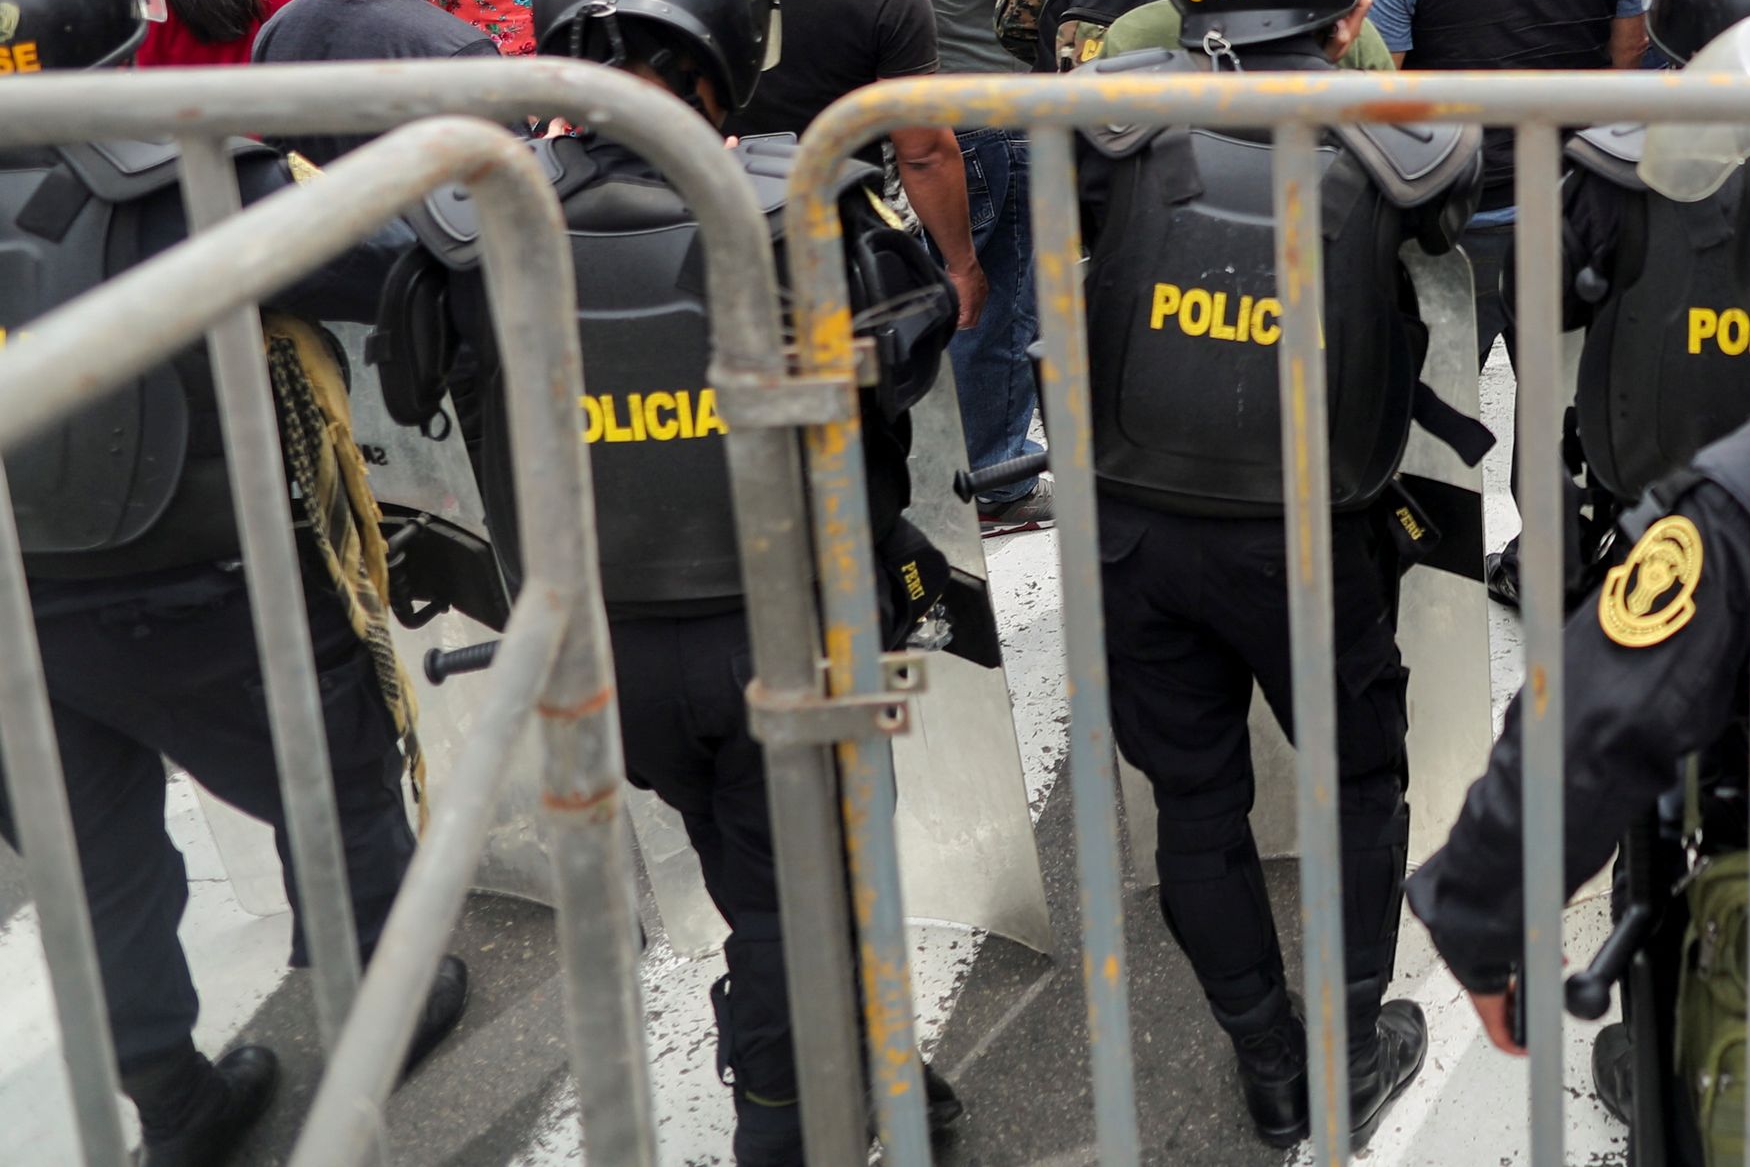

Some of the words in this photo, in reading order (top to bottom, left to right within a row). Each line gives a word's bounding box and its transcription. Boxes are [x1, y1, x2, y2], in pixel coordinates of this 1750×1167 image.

[0, 40, 41, 74] SE
[1150, 282, 1326, 349] POLIC
[577, 388, 729, 444] OLICIA
